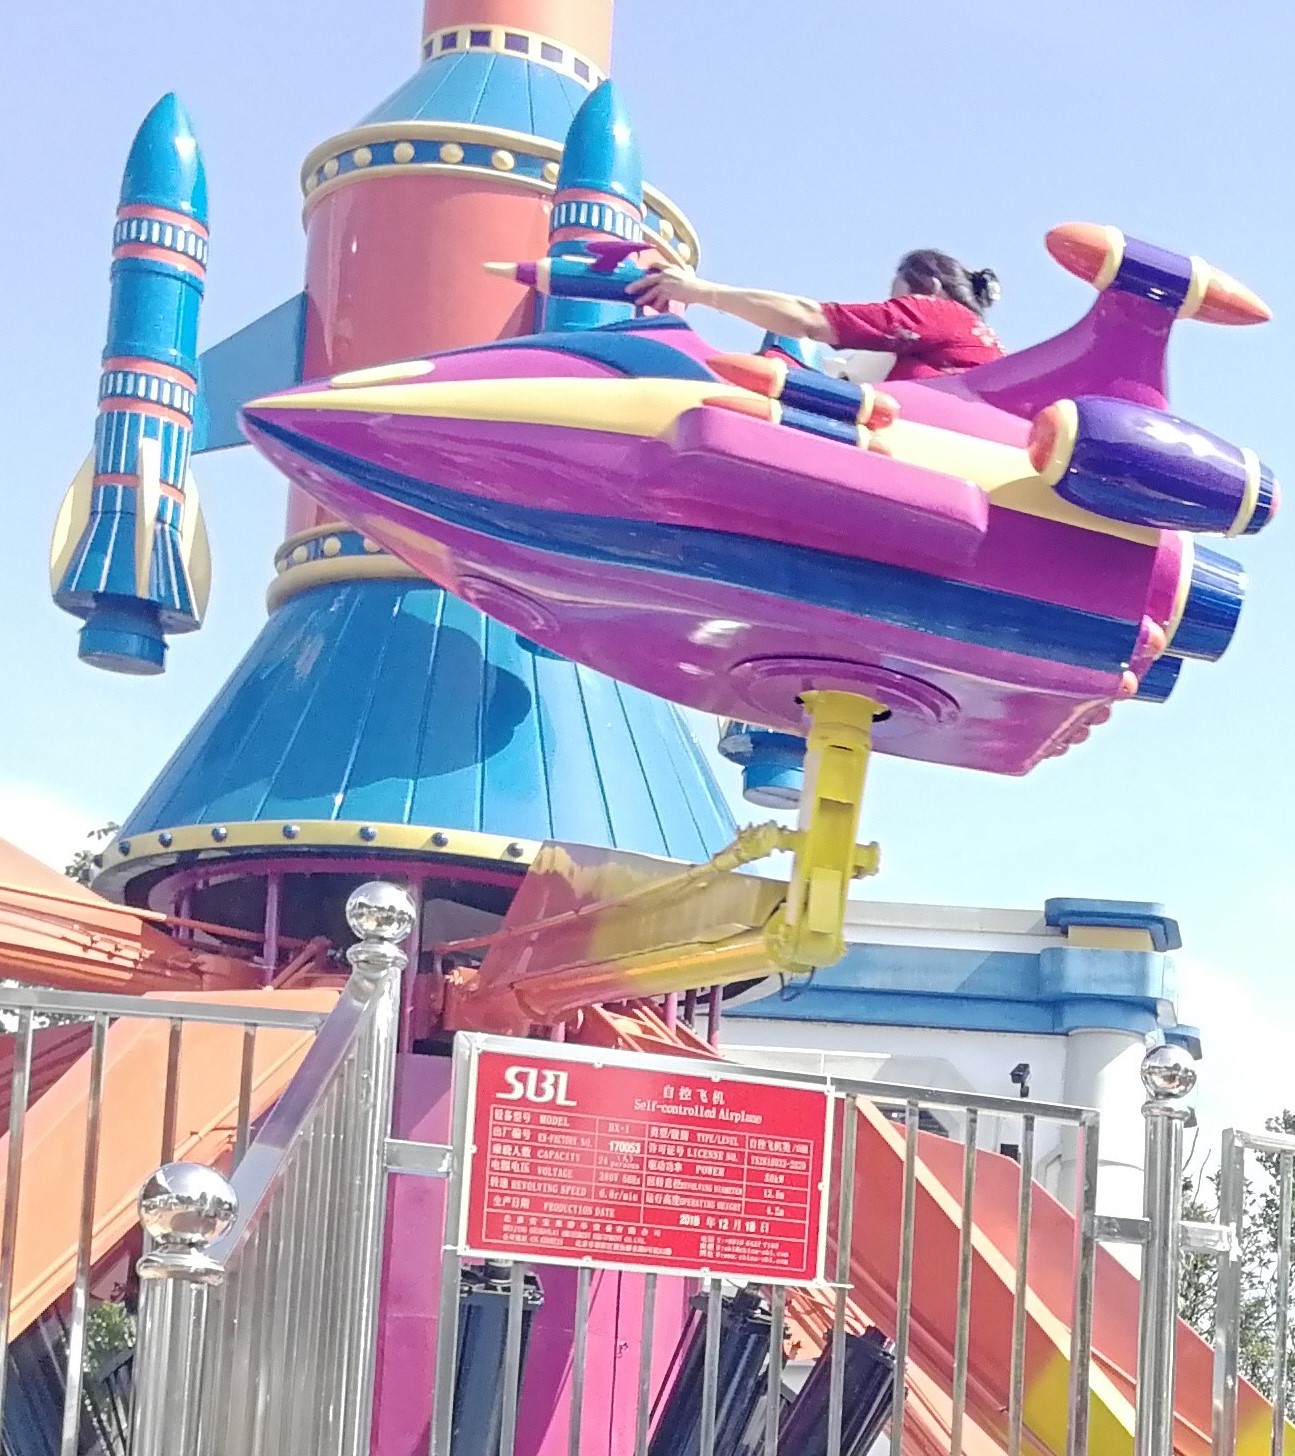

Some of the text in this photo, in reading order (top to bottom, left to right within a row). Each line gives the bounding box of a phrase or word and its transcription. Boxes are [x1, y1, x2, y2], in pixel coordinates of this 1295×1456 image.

[663, 1084, 724, 1105] 自控飞机
[634, 1099, 762, 1125] Self-controlled Airplane
[718, 1218, 728, 1229] 12
